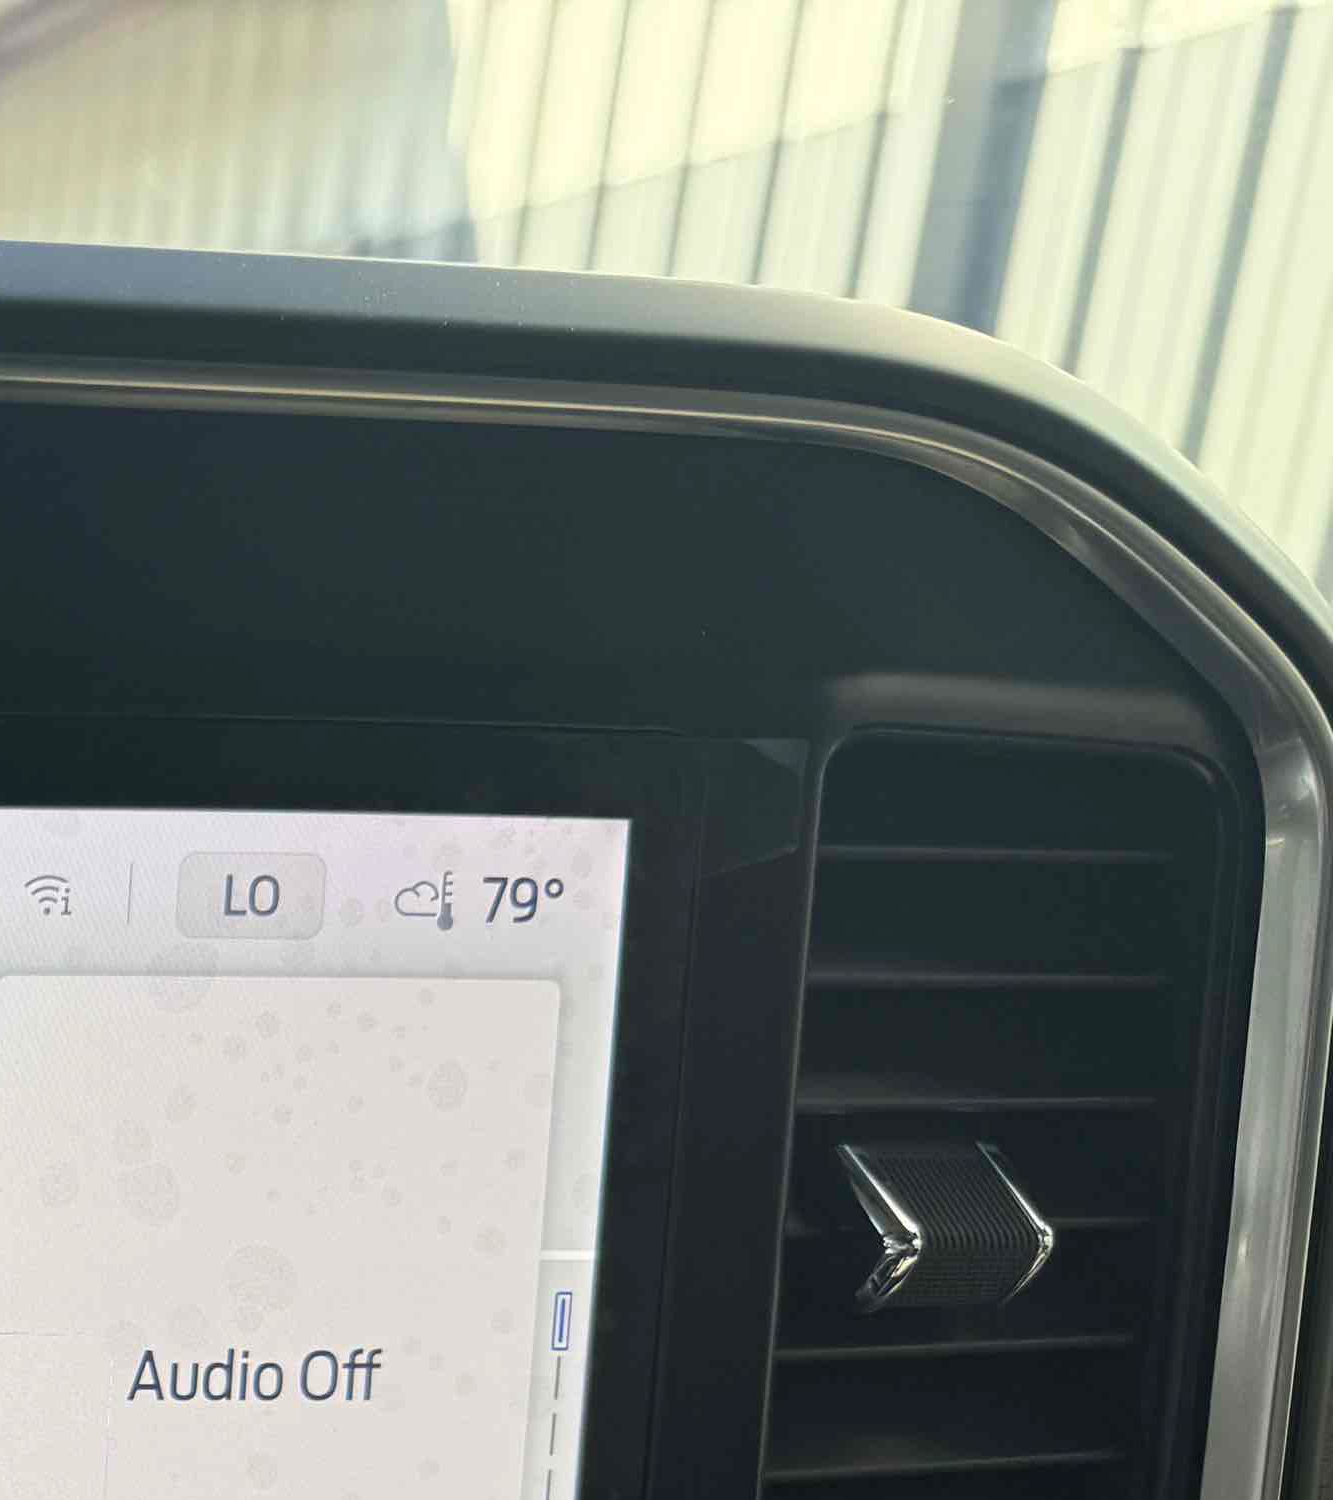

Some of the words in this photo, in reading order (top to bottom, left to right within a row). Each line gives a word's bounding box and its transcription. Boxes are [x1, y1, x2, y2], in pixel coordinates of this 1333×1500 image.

[223, 874, 280, 917] LO
[128, 1349, 283, 1401] Audio
[300, 1349, 383, 1401] Off
